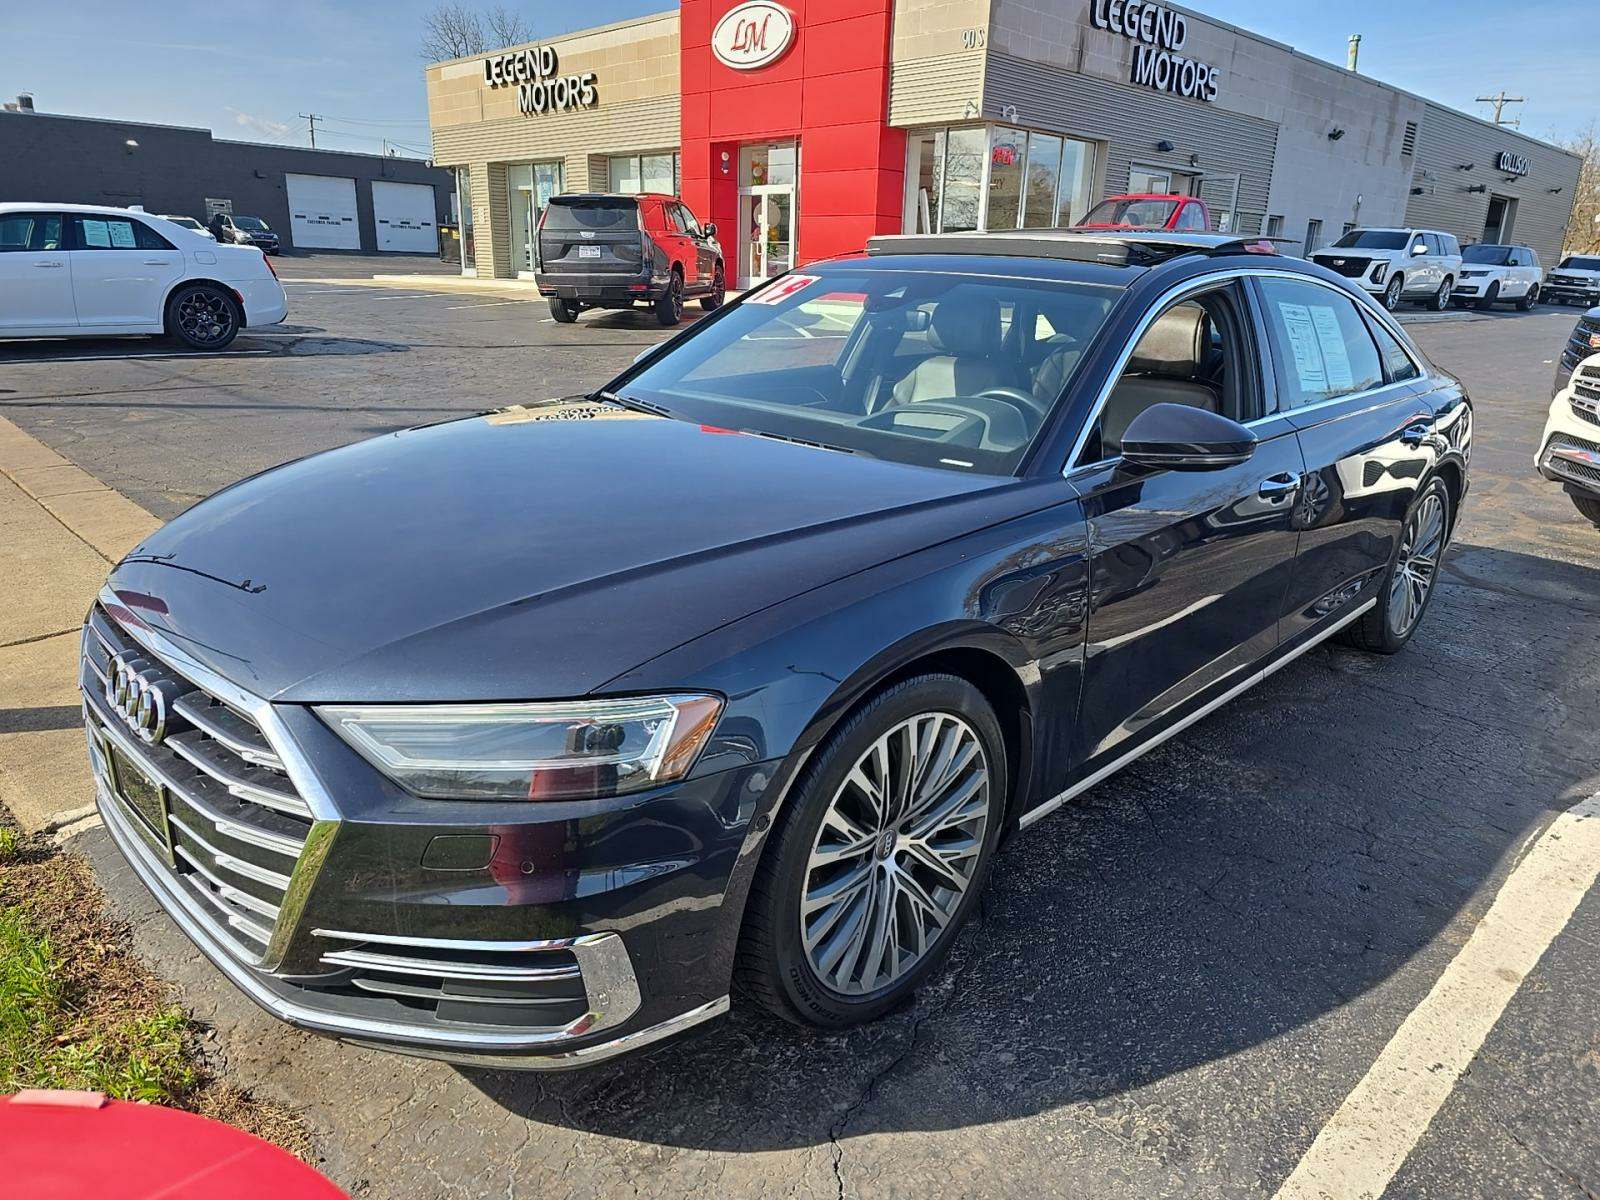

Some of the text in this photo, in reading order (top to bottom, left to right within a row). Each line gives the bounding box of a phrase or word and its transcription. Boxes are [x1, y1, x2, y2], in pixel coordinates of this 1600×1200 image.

[731, 13, 771, 54] LM
[962, 30, 976, 48] 90
[1091, 0, 1187, 50] LEGEND
[484, 46, 558, 87] LEGEND
[1132, 46, 1220, 101] MOTORS
[517, 73, 597, 113] MOTORS
[1497, 151, 1534, 176] COLLISION
